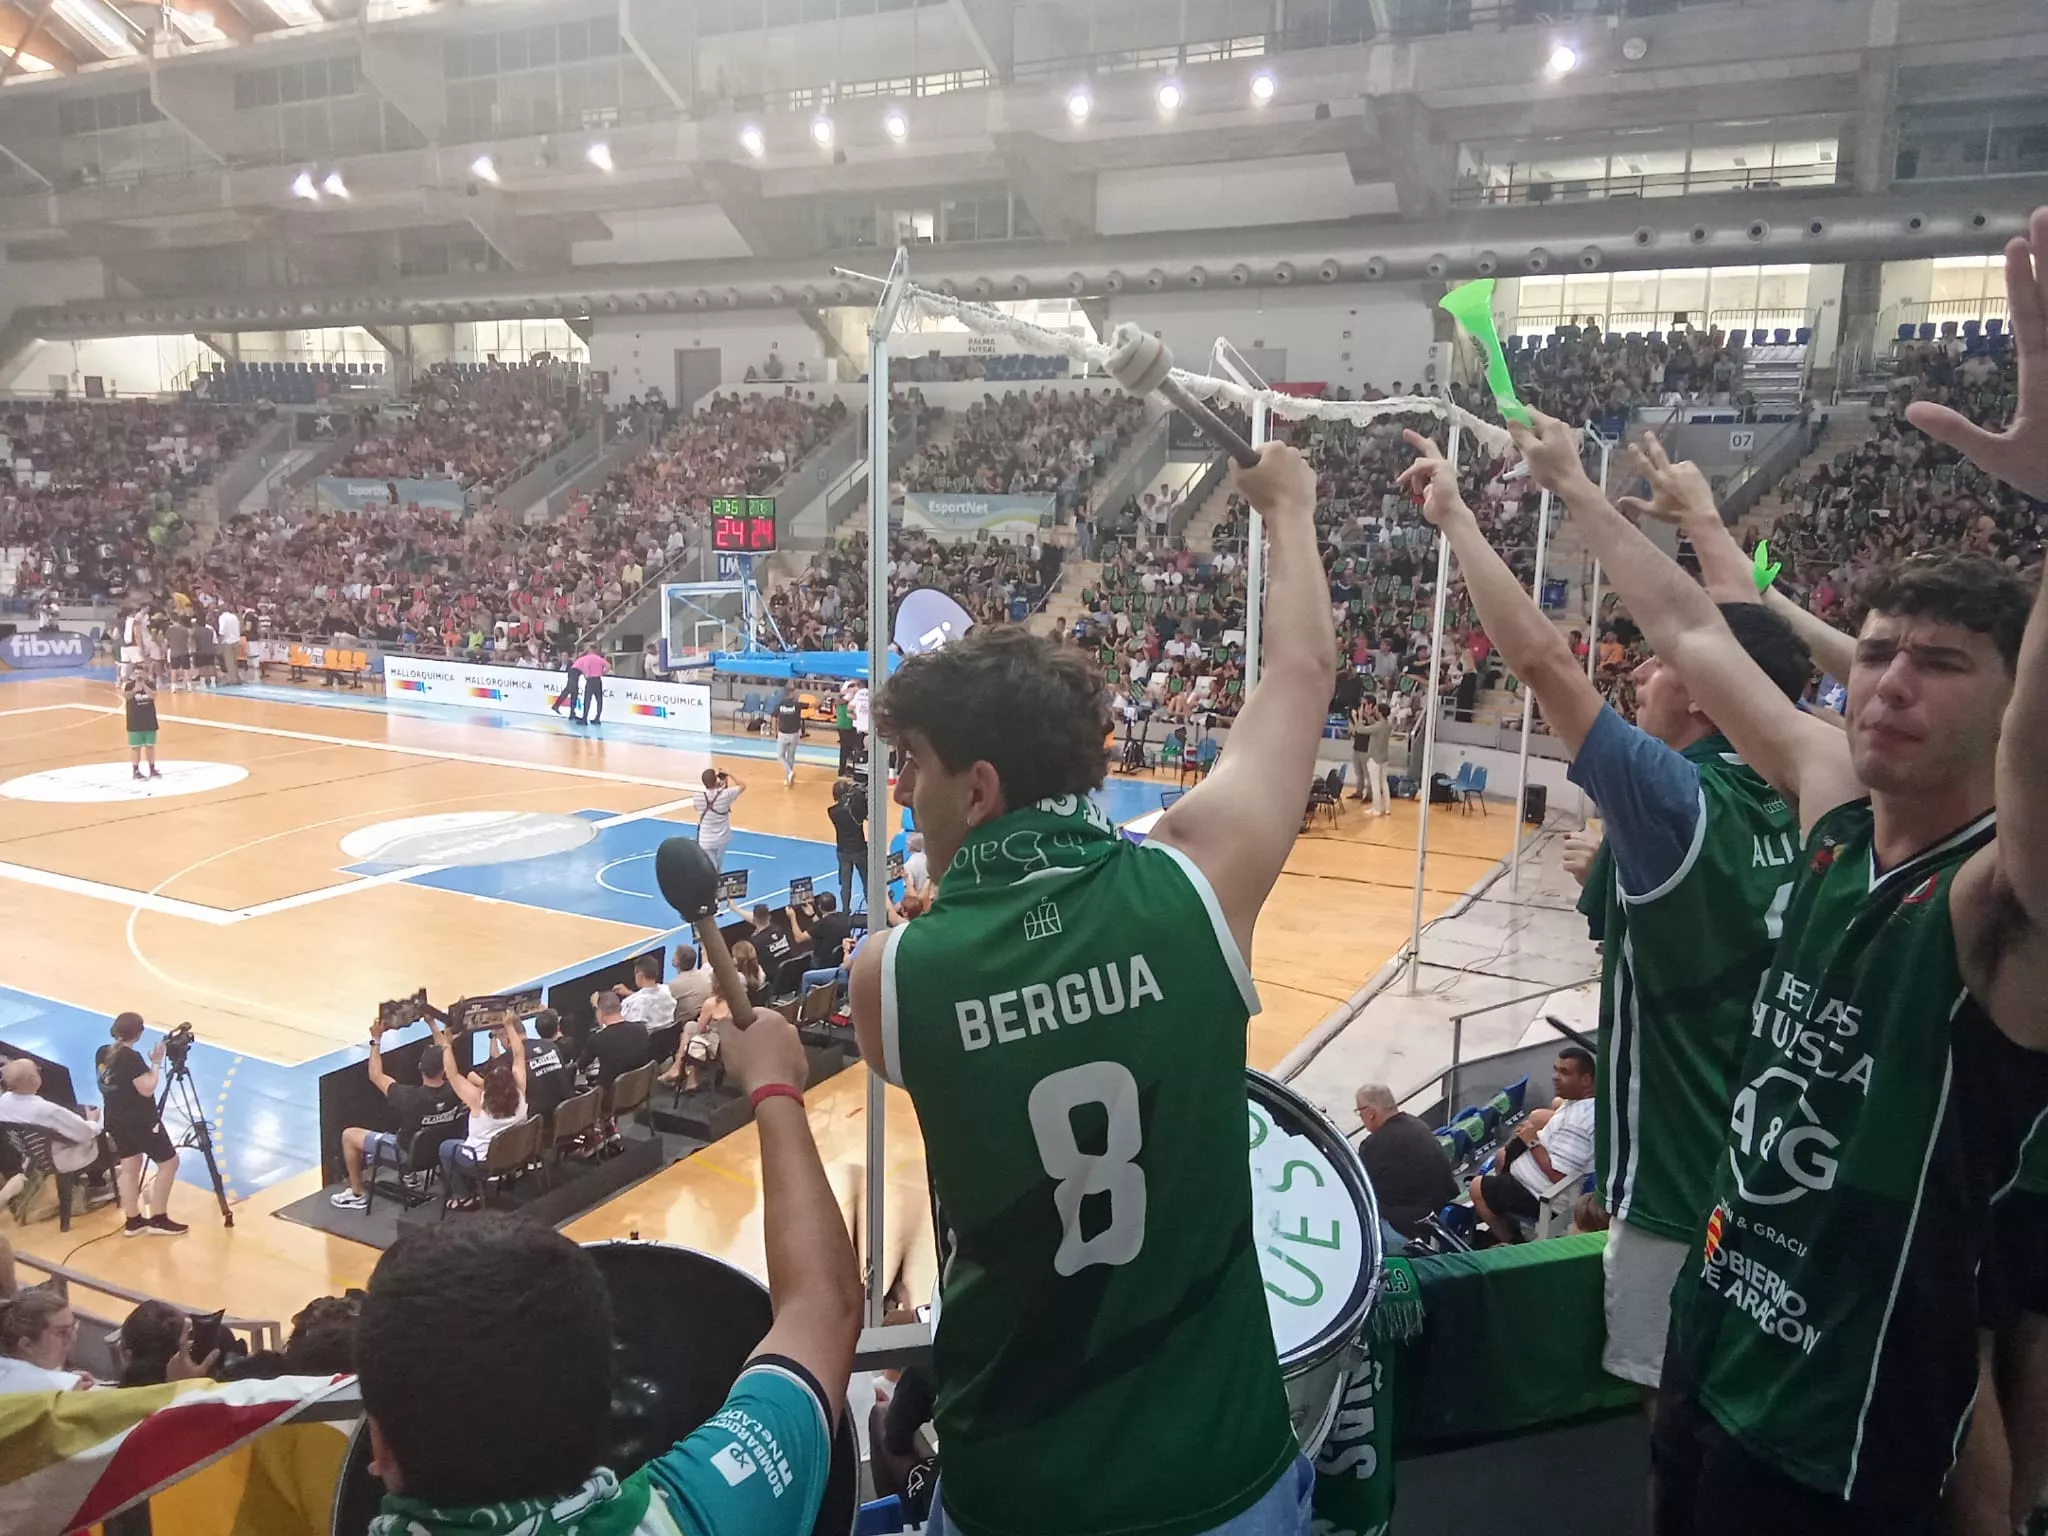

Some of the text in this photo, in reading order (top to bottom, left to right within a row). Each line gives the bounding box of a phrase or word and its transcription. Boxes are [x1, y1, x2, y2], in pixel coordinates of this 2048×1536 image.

[967, 337, 996, 345] PALMA
[1732, 434, 1752, 447] 07
[928, 500, 988, 514] EsportNet
[716, 518, 744, 547] 24
[751, 518, 773, 548] 24
[10, 633, 82, 657] fibwi
[955, 954, 1164, 1052] BERGUA
[1028, 1060, 1147, 1277] 8
